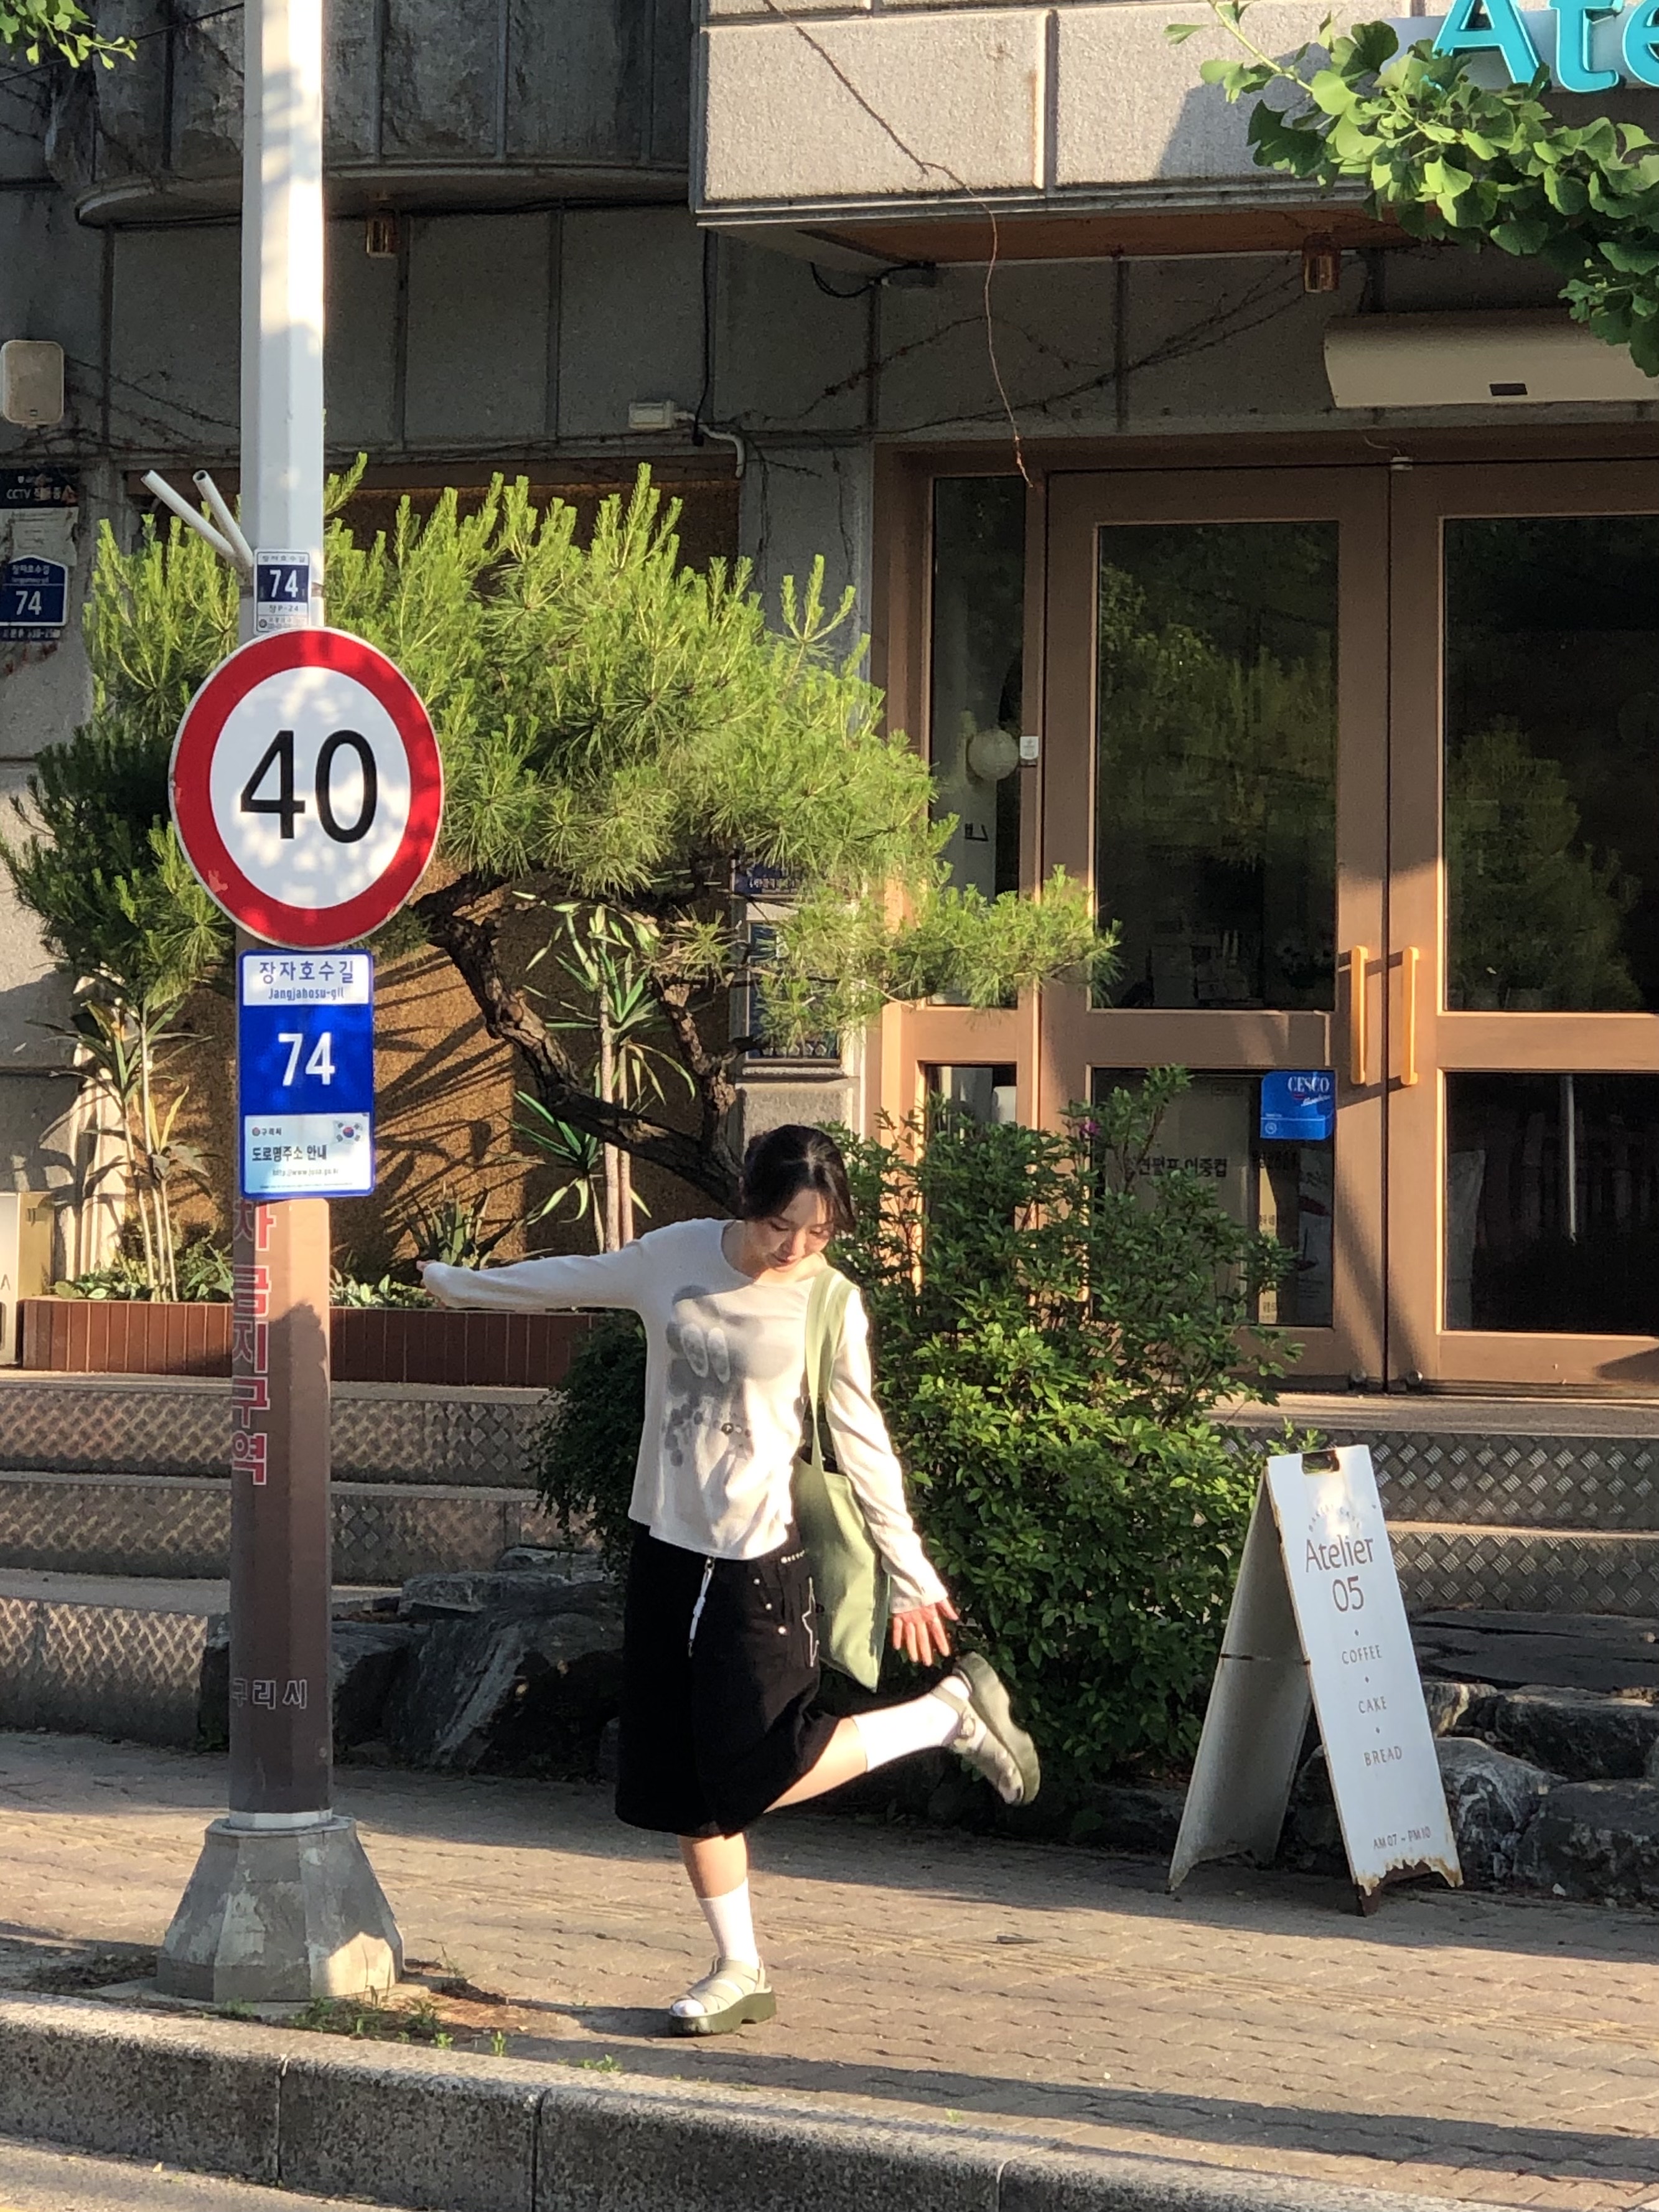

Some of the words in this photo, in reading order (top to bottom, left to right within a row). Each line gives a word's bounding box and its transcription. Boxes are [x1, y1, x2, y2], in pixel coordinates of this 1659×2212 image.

[6, 489, 31, 499] CCTV
[269, 569, 299, 598] 74
[15, 591, 42, 615] 74
[240, 730, 378, 843] 40
[259, 960, 354, 985] 장자호수길
[268, 986, 344, 1001] Jangjahosu-gil
[278, 1031, 336, 1086] 74
[1287, 1076, 1330, 1093] CESCO
[252, 1146, 303, 1163] 도로명주소
[307, 1145, 327, 1161] 안내
[1306, 1534, 1373, 1573] Atelier
[1332, 1575, 1364, 1612] 05
[1342, 1645, 1382, 1665] COFFEE
[232, 1677, 307, 1710] 구리시
[1358, 1696, 1387, 1713] CAKE
[1364, 1746, 1402, 1766] BREAD
